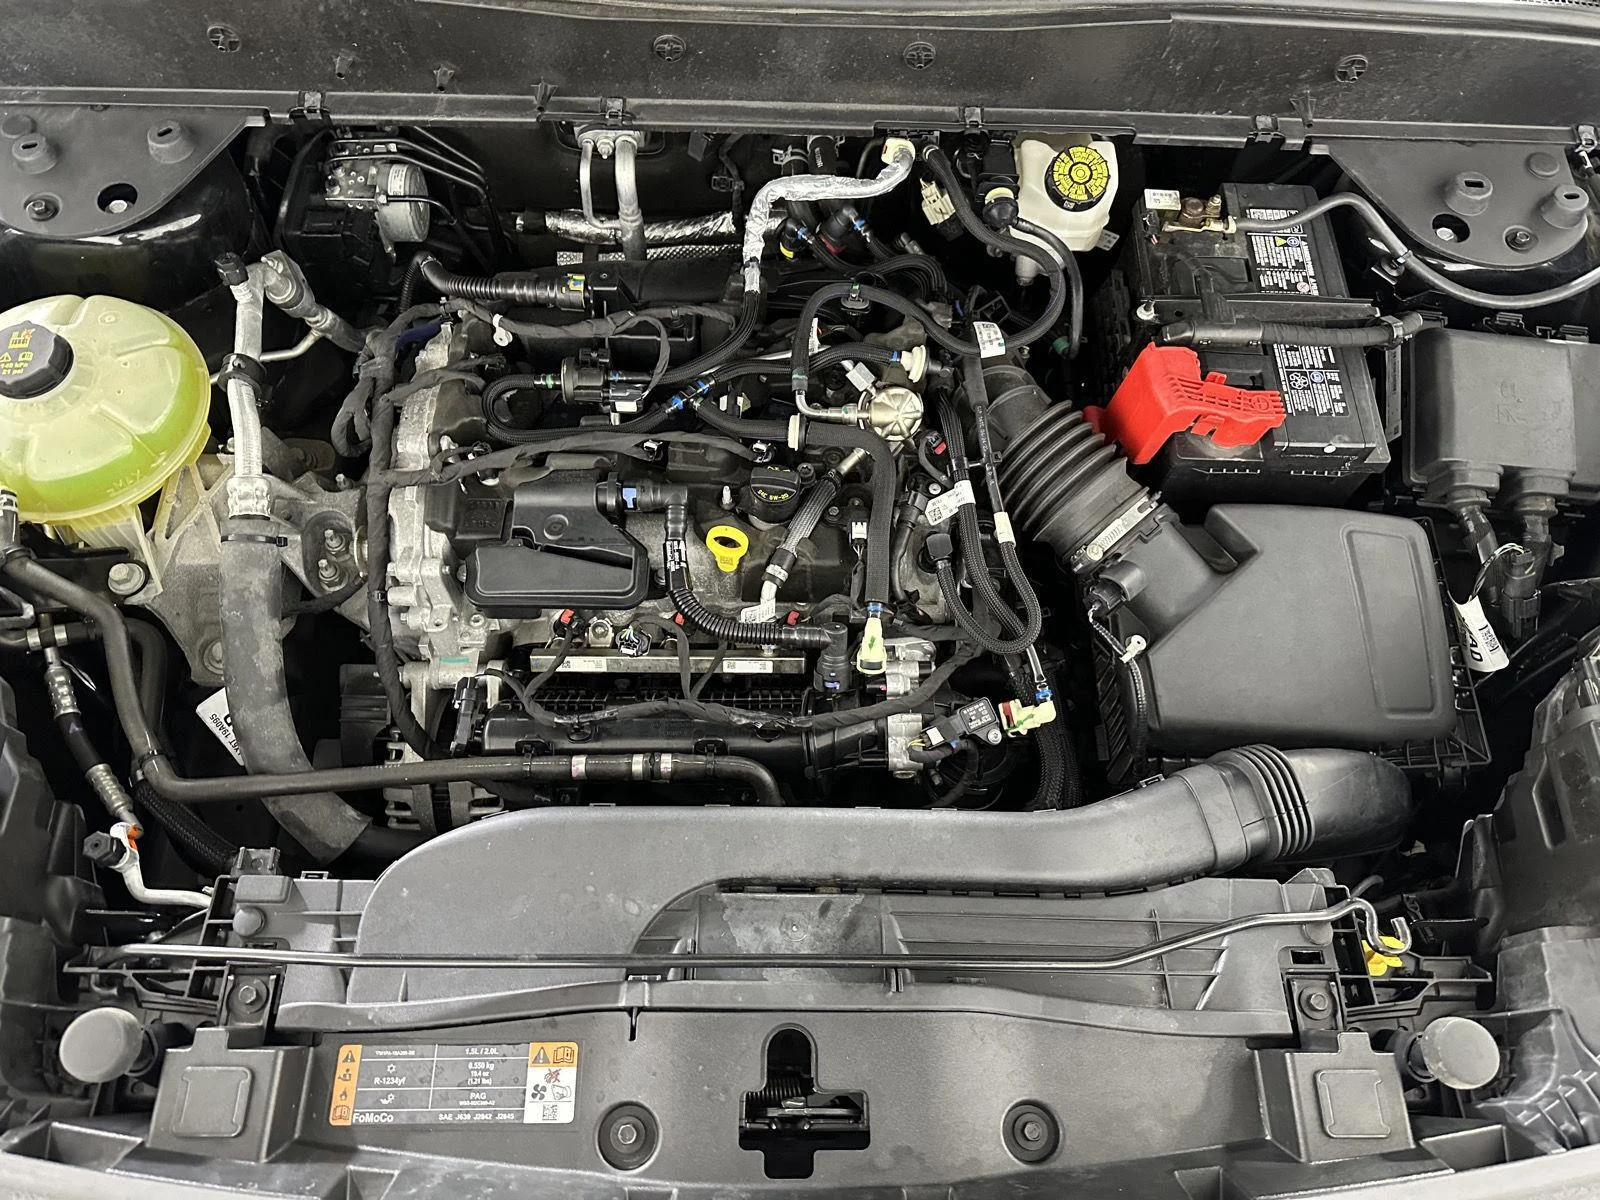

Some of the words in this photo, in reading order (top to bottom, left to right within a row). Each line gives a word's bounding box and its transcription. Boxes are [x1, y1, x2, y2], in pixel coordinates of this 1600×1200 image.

[209, 713, 231, 739] 19A095
[465, 1047, 480, 1055] 1.5L
[484, 1047, 500, 1055] 2.0L
[486, 1061, 495, 1071] kg
[373, 1076, 407, 1087] R-1234yf
[469, 1092, 487, 1100] PAG
[352, 1112, 394, 1124] FoMoCo
[438, 1113, 454, 1121] SAE
